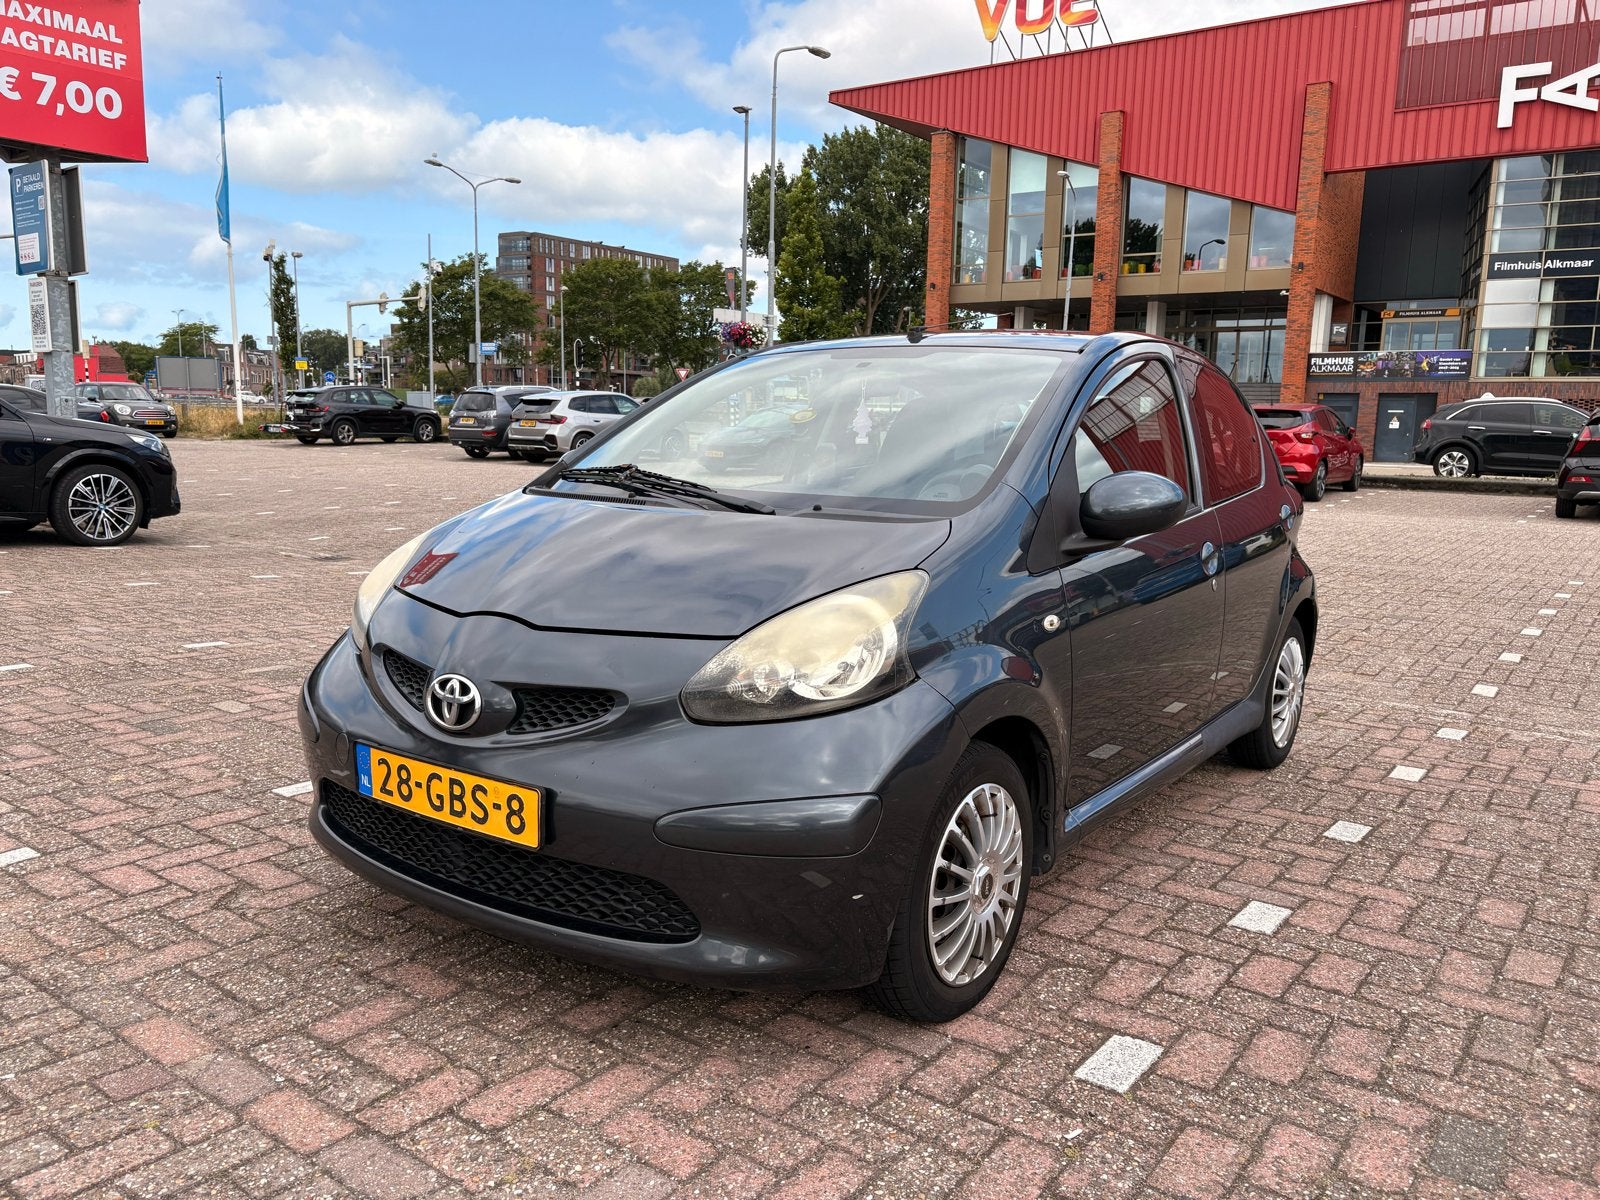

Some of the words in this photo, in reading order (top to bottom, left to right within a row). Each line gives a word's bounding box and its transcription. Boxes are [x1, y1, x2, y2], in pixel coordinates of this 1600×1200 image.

[0, 0, 123, 44] AXIMAAL
[31, 72, 123, 119] 7,00
[22, 172, 41, 184] BETAALD
[1494, 260, 1542, 271] Filmhuis
[1544, 258, 1594, 270] Alkmaar
[1310, 364, 1354, 373] ALKMAAR
[1311, 357, 1354, 366] FILMHUIS
[361, 773, 372, 788] NL
[377, 757, 526, 835] 28-GBS-8
